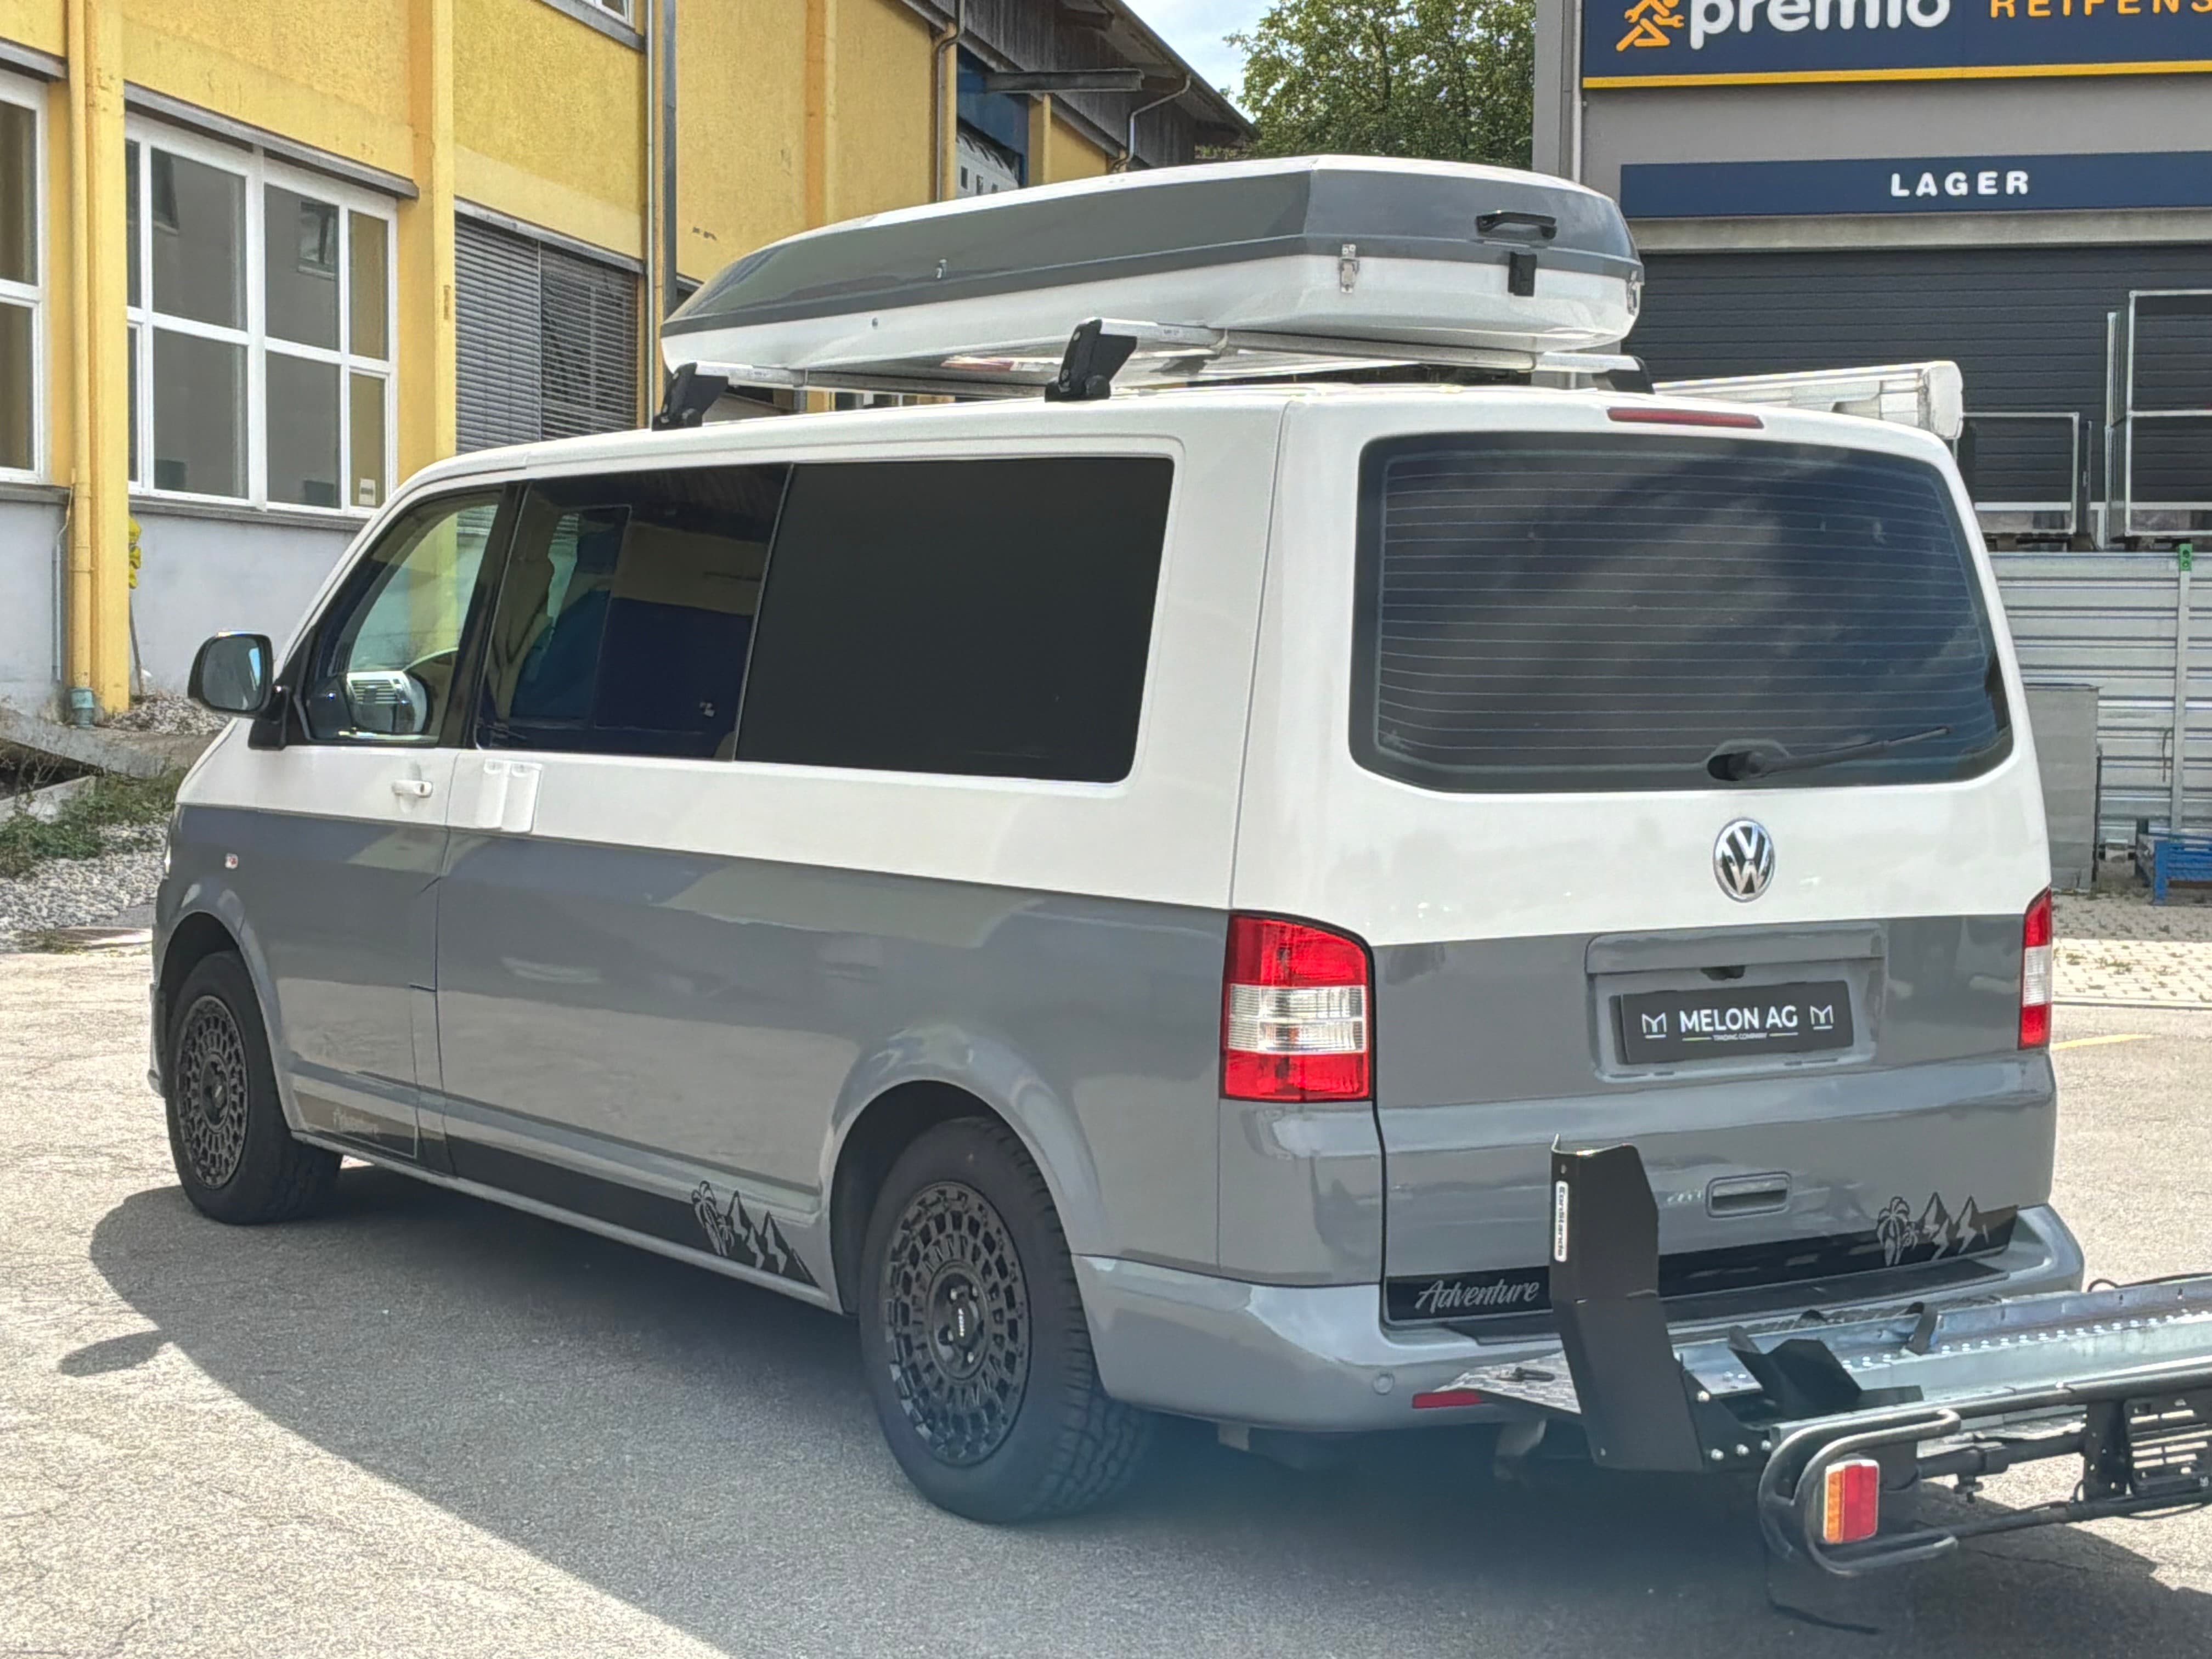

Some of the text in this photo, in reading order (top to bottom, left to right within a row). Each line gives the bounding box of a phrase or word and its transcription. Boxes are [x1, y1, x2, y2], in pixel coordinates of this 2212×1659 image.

[1891, 171, 2029, 196] LAGER
[1679, 1007, 1759, 1033] MELON
[1766, 1005, 1798, 1029] AG
[1414, 1278, 1539, 1314] Adventure
